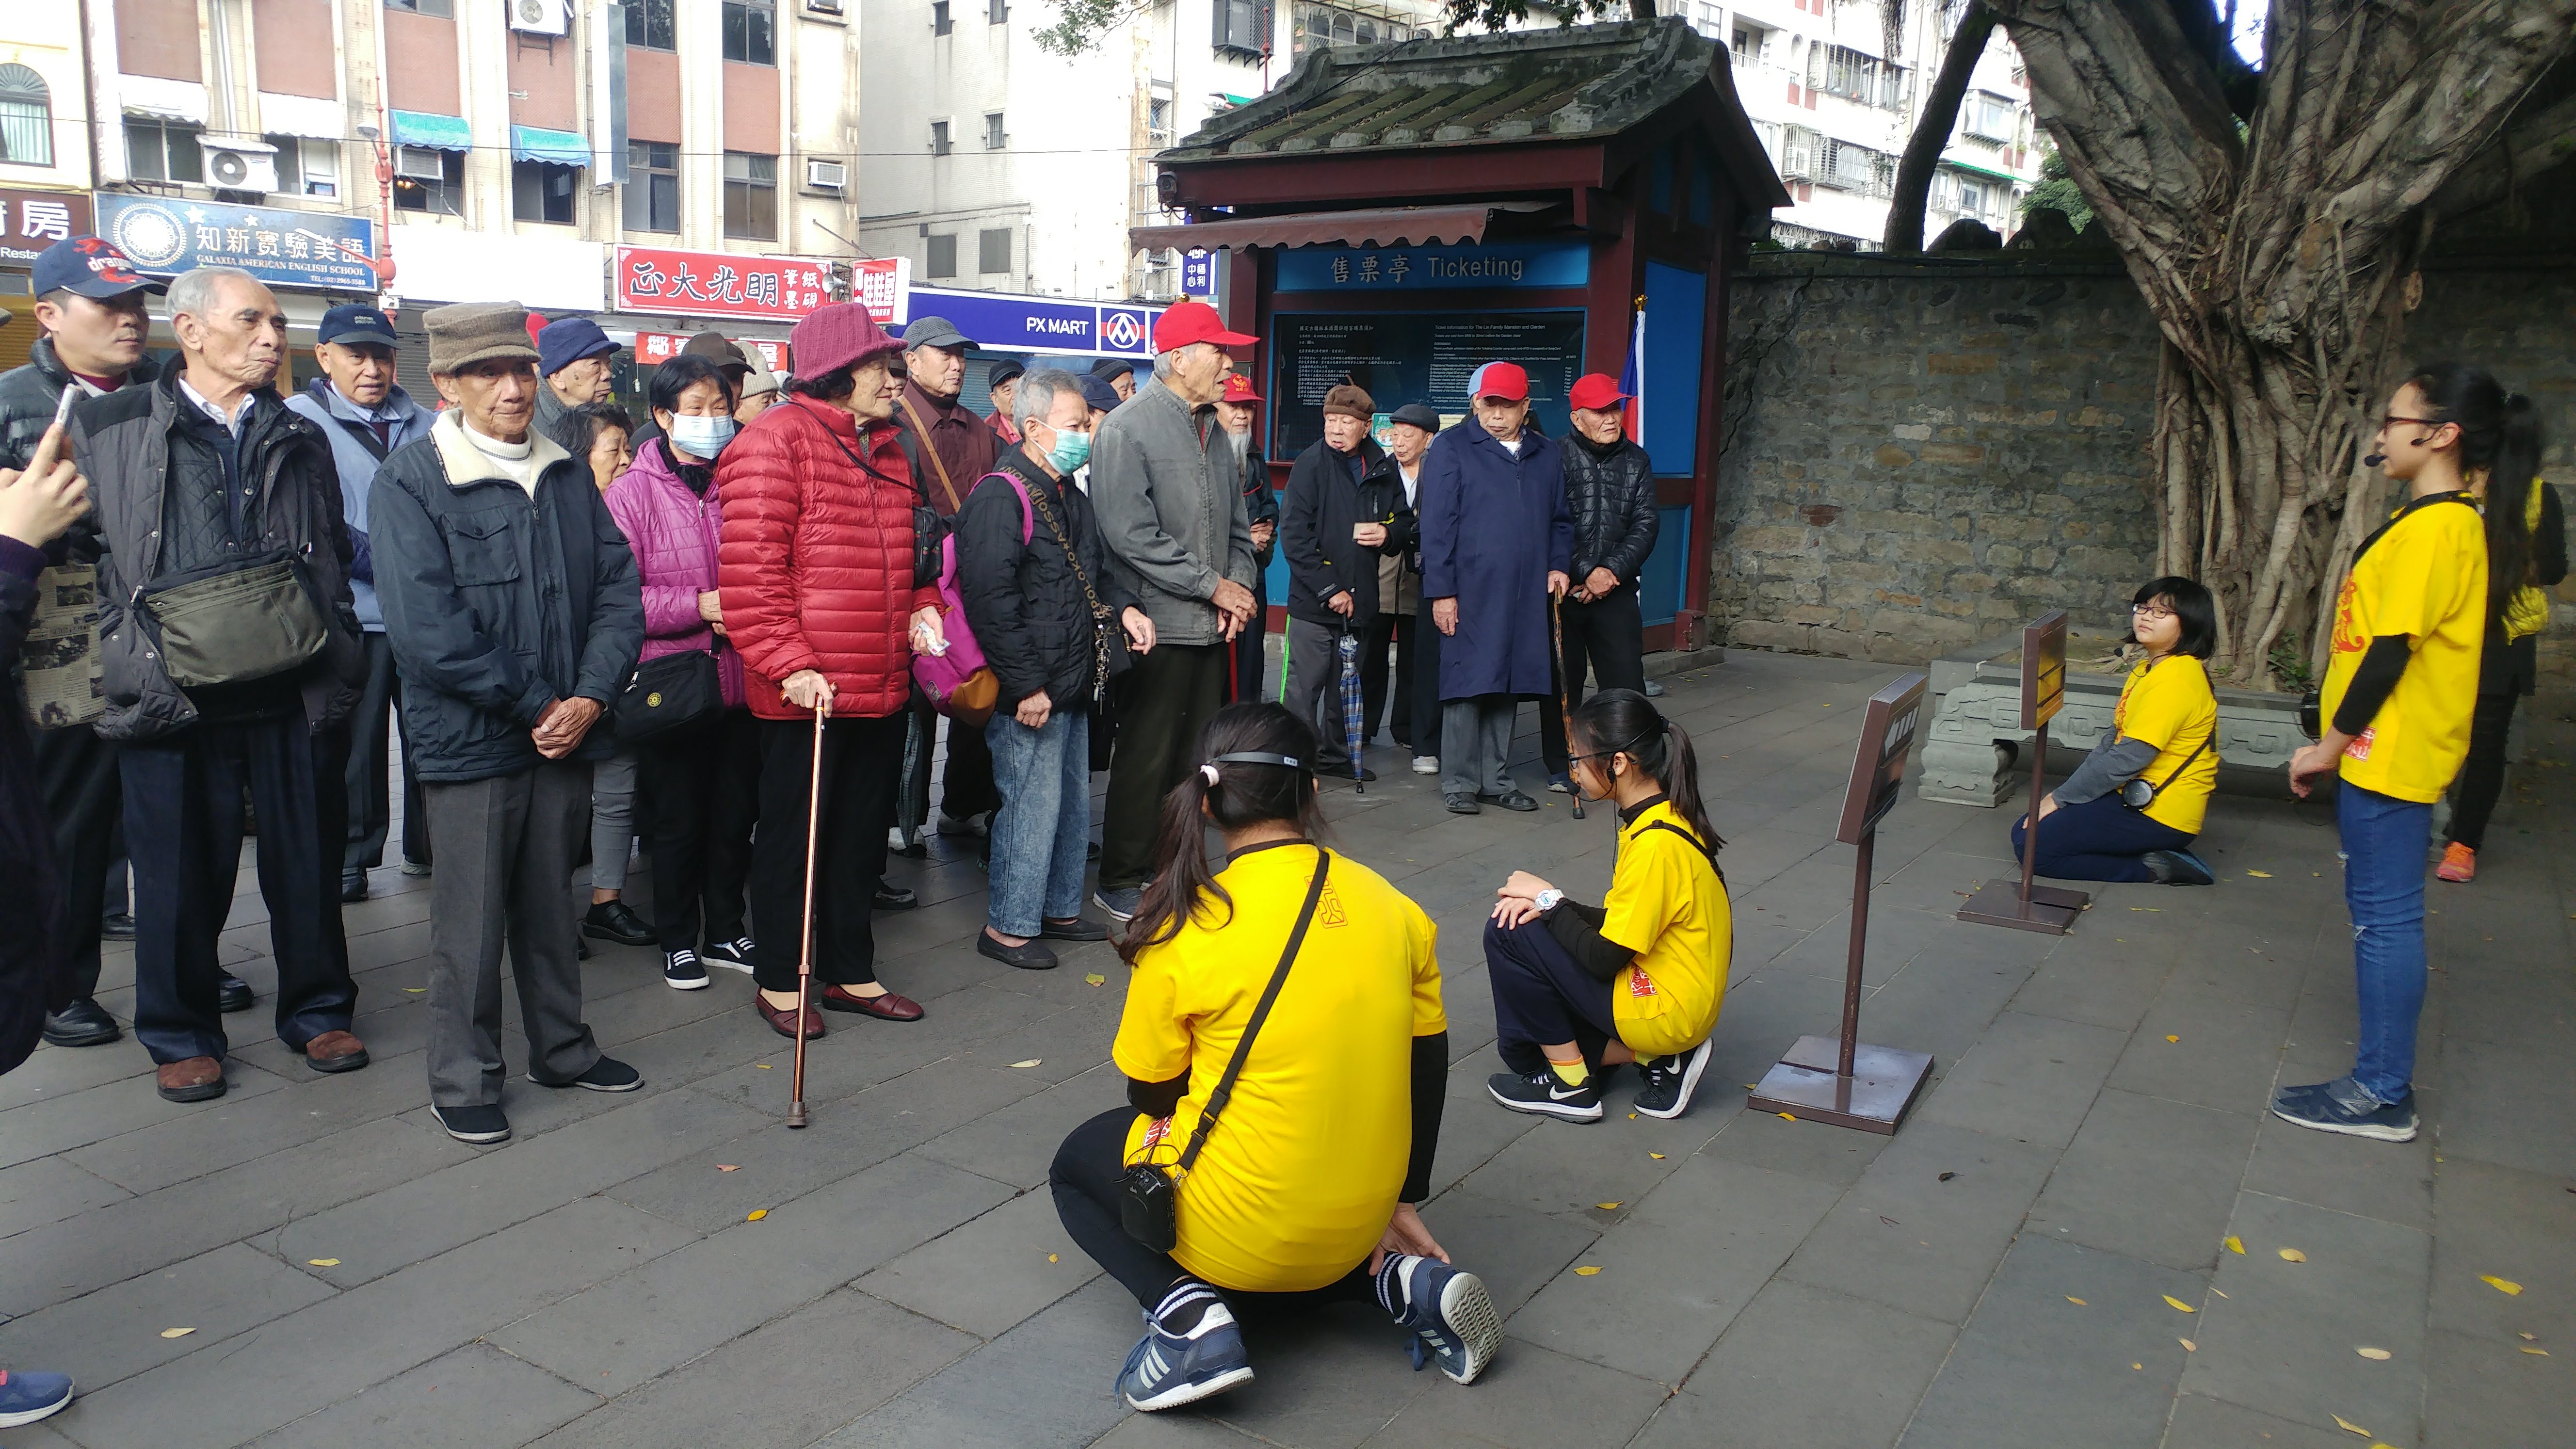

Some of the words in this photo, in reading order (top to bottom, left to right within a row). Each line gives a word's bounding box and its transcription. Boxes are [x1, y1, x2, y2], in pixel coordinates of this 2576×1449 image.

[0, 247, 41, 260] Resta
[196, 254, 237, 265] GALAXIA
[239, 258, 286, 270] AMERICAN
[289, 262, 328, 273] ENGLISH
[329, 266, 365, 276] SCHOOL
[1330, 254, 1410, 284] 售票亭
[1427, 256, 1523, 281] Ticketing
[1026, 317, 1046, 333] PX
[1048, 318, 1089, 336] MART
